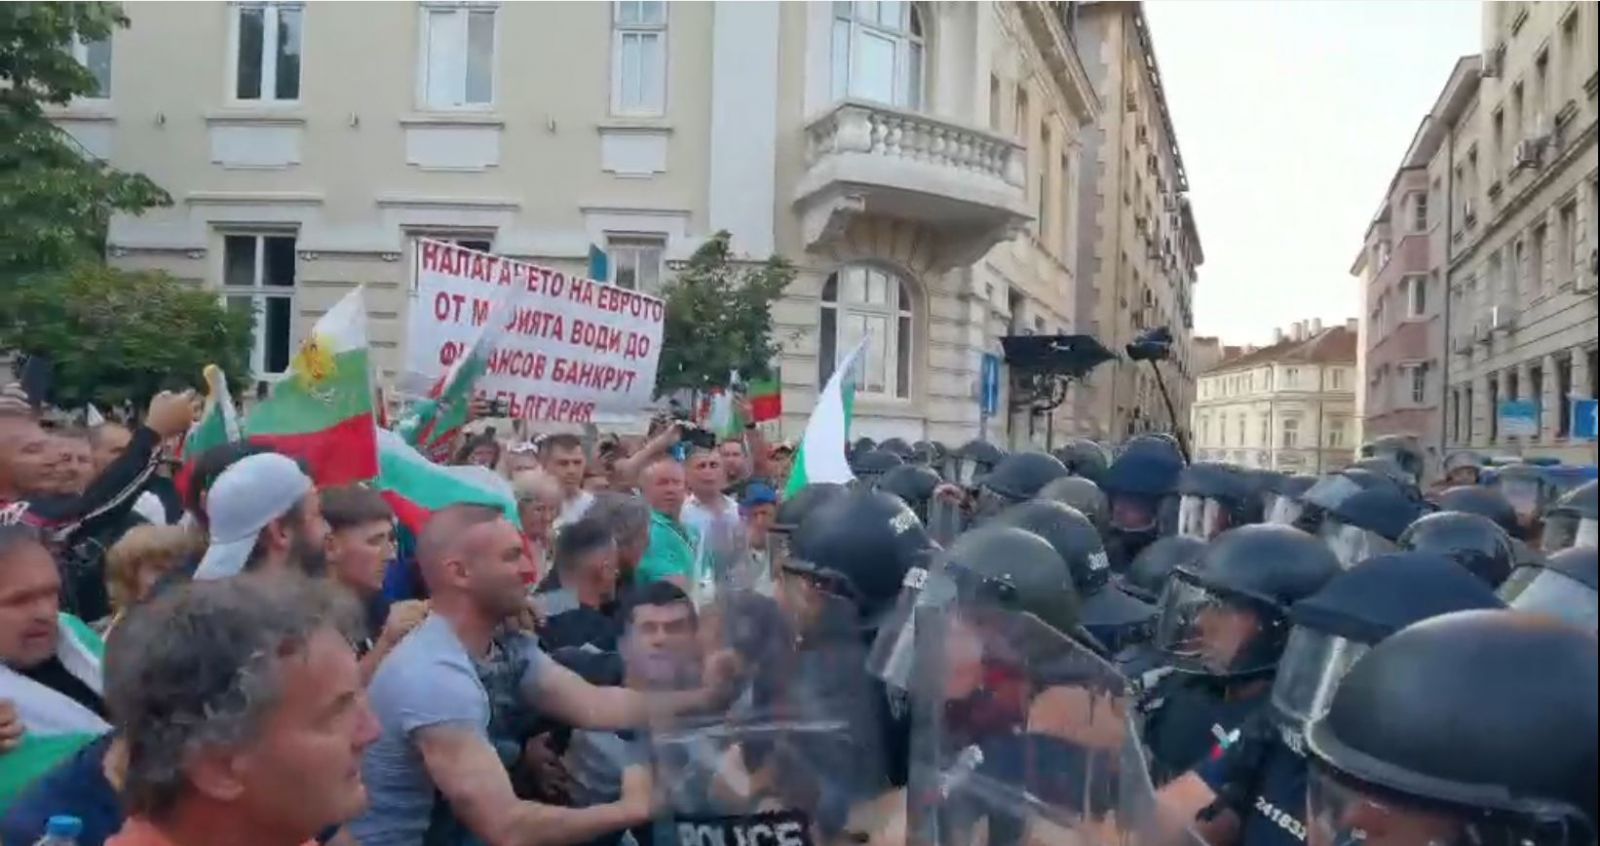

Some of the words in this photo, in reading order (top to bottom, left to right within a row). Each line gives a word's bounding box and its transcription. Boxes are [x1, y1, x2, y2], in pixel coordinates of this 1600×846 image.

[423, 241, 565, 298] НАЛАГАЕТО
[569, 276, 593, 305] НА
[598, 285, 663, 323] ЕВРОТО
[435, 291, 466, 323] ОТ
[471, 299, 563, 341] МИЯТА
[570, 319, 621, 354] ВОДИ
[623, 332, 650, 361] ДО
[440, 341, 547, 380] ФАНСОВ
[552, 357, 636, 393] БАНКРУТ
